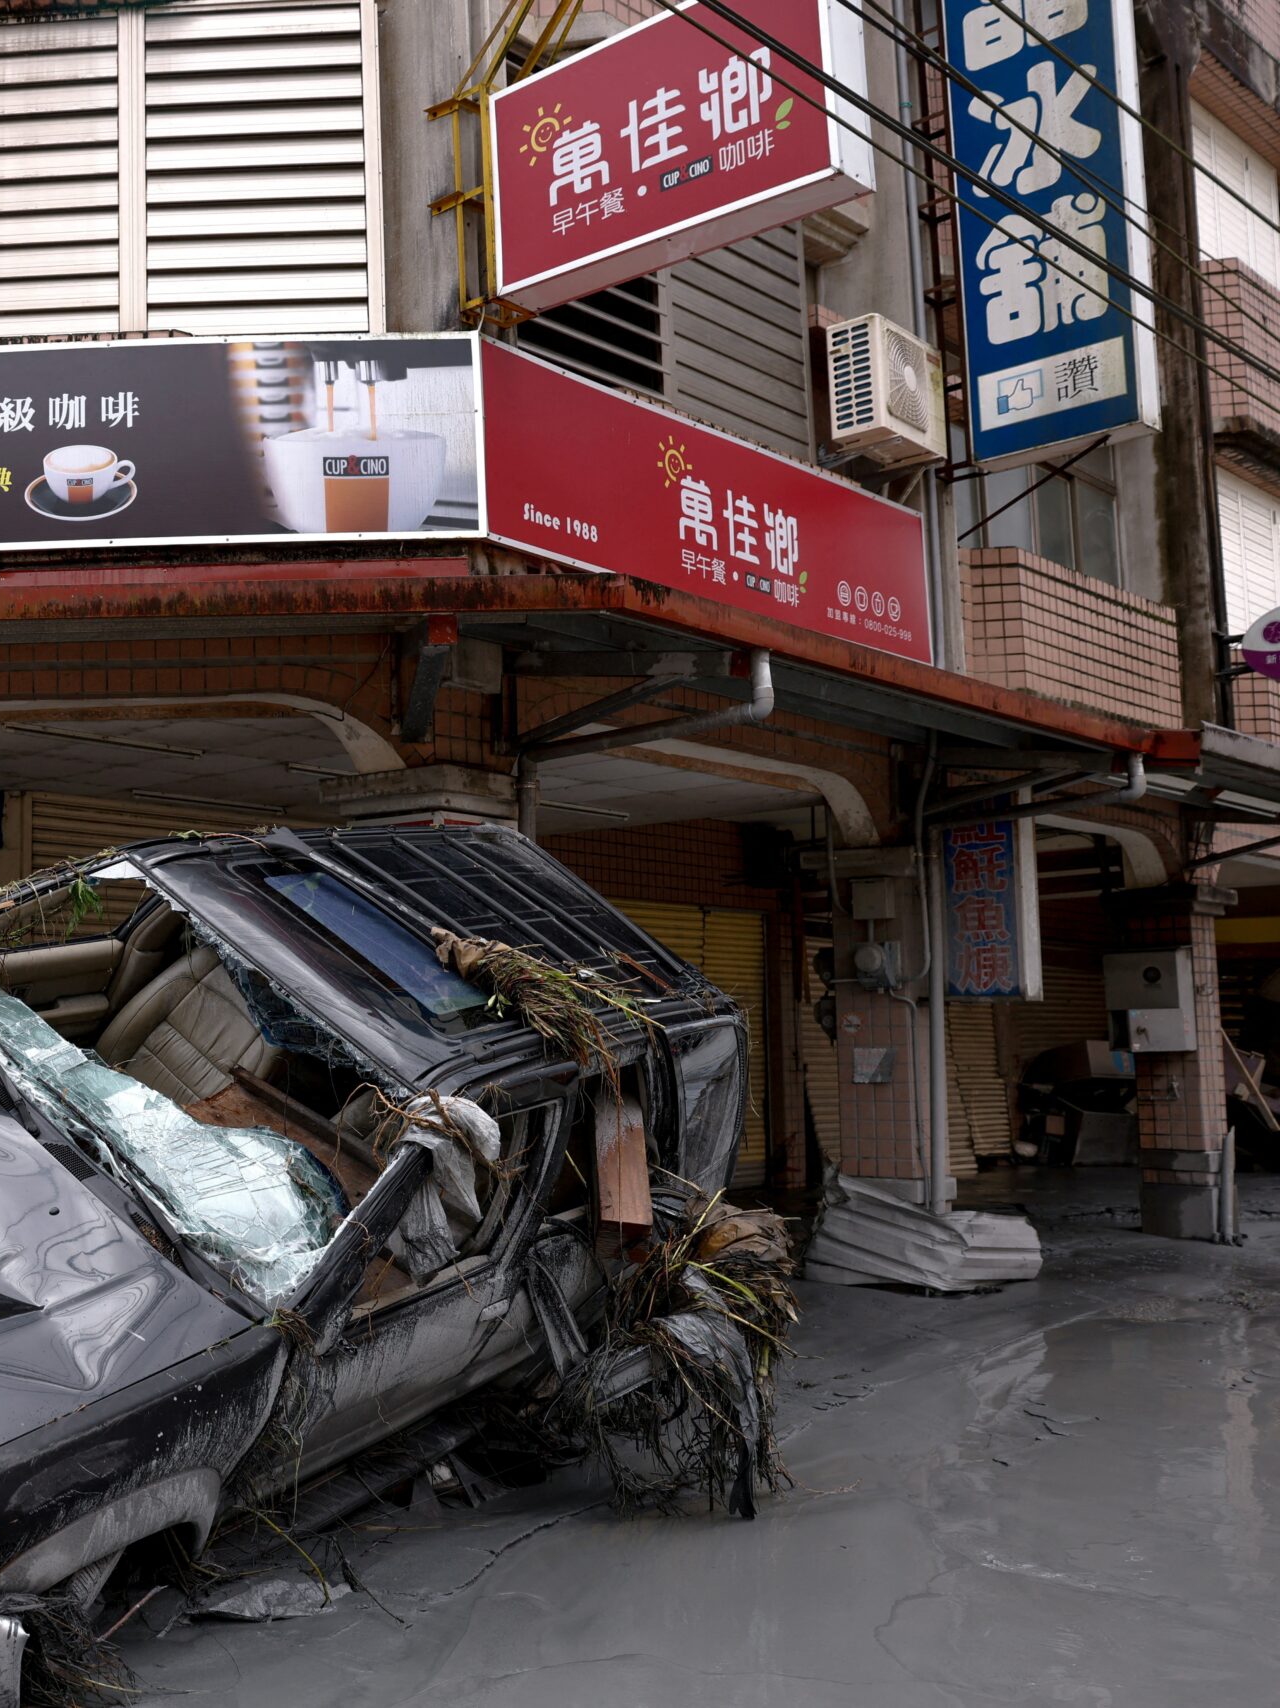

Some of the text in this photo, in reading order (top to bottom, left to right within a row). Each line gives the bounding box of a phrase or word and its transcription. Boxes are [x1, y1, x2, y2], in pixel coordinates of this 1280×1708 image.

[549, 46, 773, 206] 萬佳鄉
[552, 187, 625, 236] 早午餐
[719, 128, 775, 173] 咖啡
[1054, 353, 1099, 402] 讚
[325, 455, 387, 475] CUP&CINO
[523, 502, 599, 543] Since 1988
[679, 475, 799, 576] 萬佳鄉
[681, 549, 727, 586] 早午餐
[774, 579, 800, 608] 咖啡
